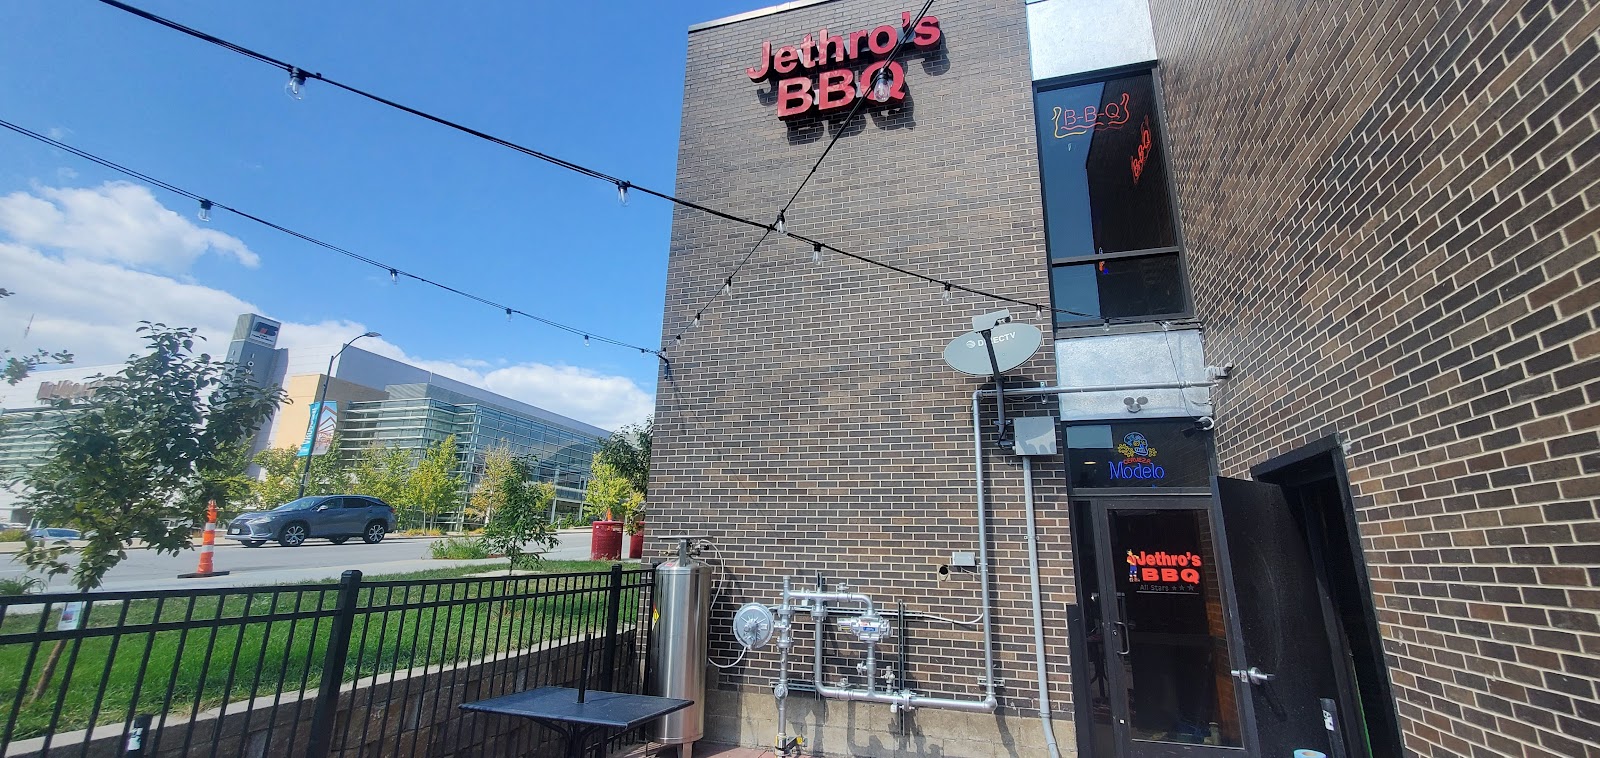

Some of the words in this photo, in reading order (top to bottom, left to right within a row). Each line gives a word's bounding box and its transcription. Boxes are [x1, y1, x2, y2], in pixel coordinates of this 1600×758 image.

[746, 11, 941, 81] Jethro's
[777, 60, 906, 119] BBQ
[977, 331, 1016, 347] DIECTV
[1108, 461, 1165, 480] Modelo
[1137, 551, 1202, 567] Jethro's
[1141, 567, 1200, 584] BBQ
[1151, 584, 1169, 592] Stars
